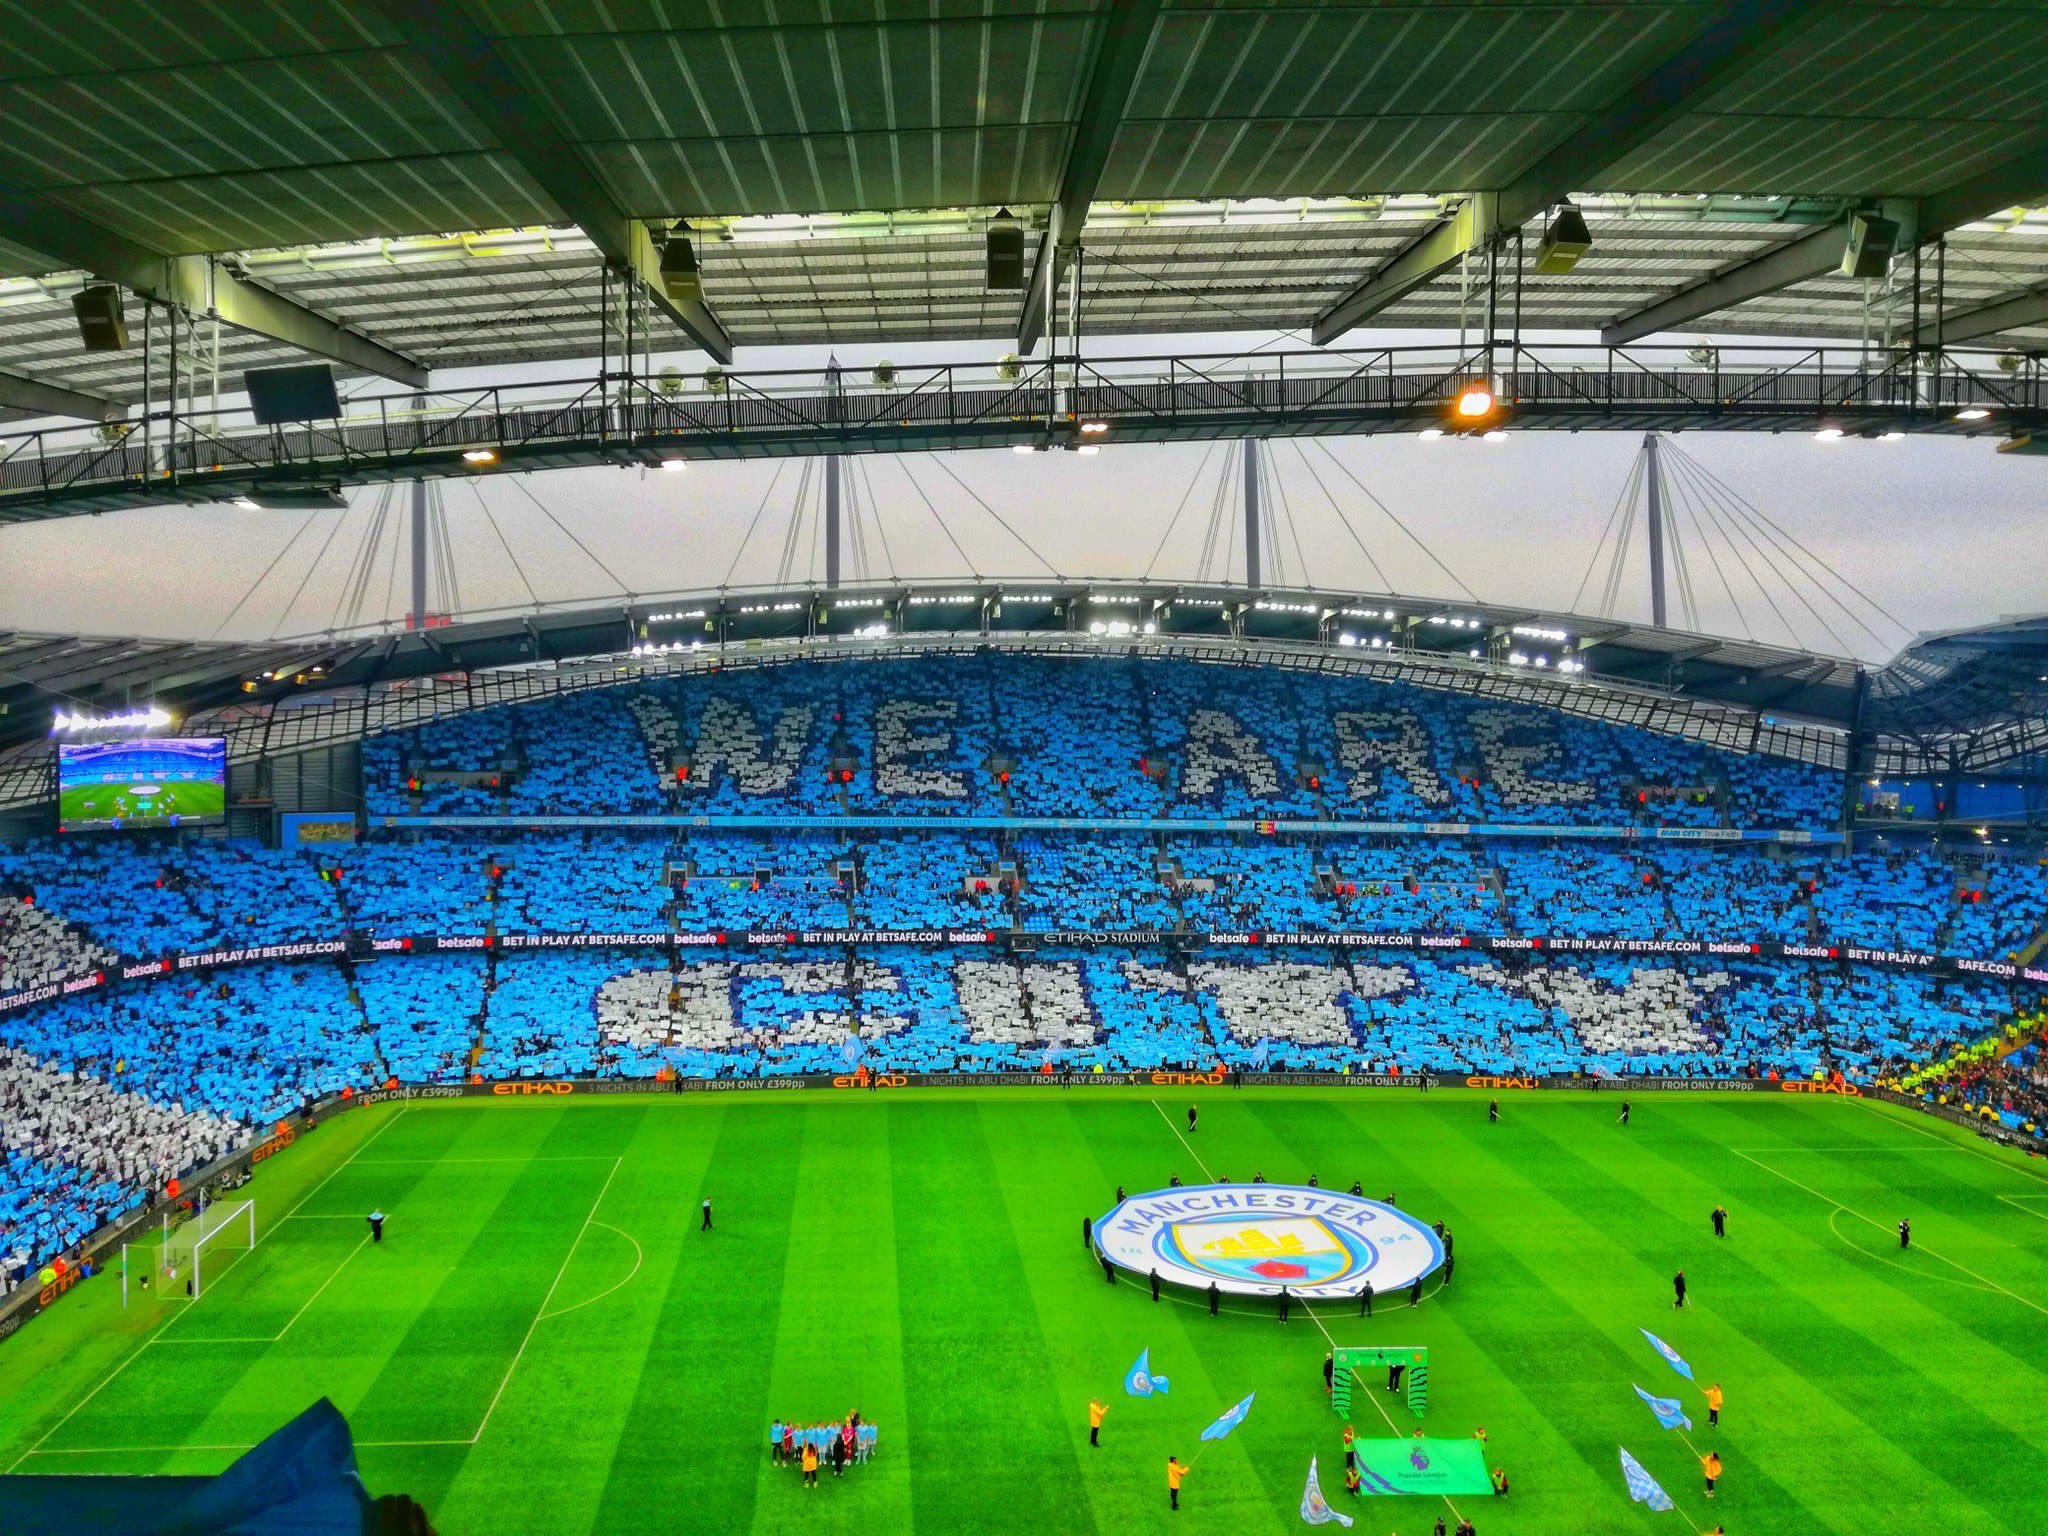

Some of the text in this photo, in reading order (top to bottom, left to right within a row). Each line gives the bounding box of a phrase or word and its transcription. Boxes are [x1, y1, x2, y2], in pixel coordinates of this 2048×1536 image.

[627, 694, 1597, 802] WE ARE
[437, 936, 484, 948] betsafe
[503, 934, 665, 946] BET IN PLAY AT BETSAFE.COM
[674, 933, 717, 944] betsafe
[803, 931, 942, 943] BET IN PLAY AT BETSAFE.COM
[949, 931, 987, 942] betsafe
[1044, 933, 1160, 943] ETIHAD STADIUM
[1209, 932, 1250, 944] betsafe
[1266, 934, 1413, 946] BET IN PLAY AT BETSAFE.COM
[1420, 936, 1462, 948] betsafe
[1492, 937, 1533, 949] betsafe
[1550, 939, 1701, 952] BET IN PLAY AT BETSAFE.COM
[1708, 942, 1751, 954] betsafe
[178, 941, 346, 968] BET IN PLAY AT BETSAFE.COM
[1783, 945, 1829, 957] betsafe
[1848, 949, 1870, 960] BET
[1872, 951, 1886, 961] IN
[1888, 952, 1918, 964] PLAY
[123, 962, 162, 978] betsafe
[63, 974, 97, 993] betsafe
[649, 1080, 670, 1091] ABU
[705, 1080, 735, 1091] FROM
[737, 1079, 765, 1090] ONLY
[767, 1079, 805, 1090] £399pp
[929, 1076, 963, 1086] NIGHTS
[966, 1075, 976, 1085] IN
[978, 1075, 998, 1085] ABU
[1000, 1075, 1029, 1085] DHABI
[1031, 1075, 1059, 1085] FROM
[1089, 1075, 1125, 1086] £399pp
[1152, 1073, 1224, 1085] ETIHAD
[1293, 1075, 1312, 1086] ABU
[1314, 1076, 1344, 1086] DHABI
[1345, 1076, 1373, 1087] FROM
[1375, 1077, 1401, 1087] ONLY
[1403, 1077, 1440, 1088] £39pp
[1609, 1079, 1629, 1090] ABU
[1631, 1079, 1660, 1090] DHABI
[1661, 1080, 1690, 1090] FROM
[1691, 1080, 1715, 1090] ONLY
[1717, 1080, 1754, 1091] £399pp
[493, 1082, 573, 1095] ETIHAD
[1781, 1080, 1858, 1095] ETIHAD
[358, 1086, 463, 1105] FROM ONLY £399pp
[252, 1130, 295, 1162] ETIHAD
[1118, 1194, 1377, 1236] MANCHESTER
